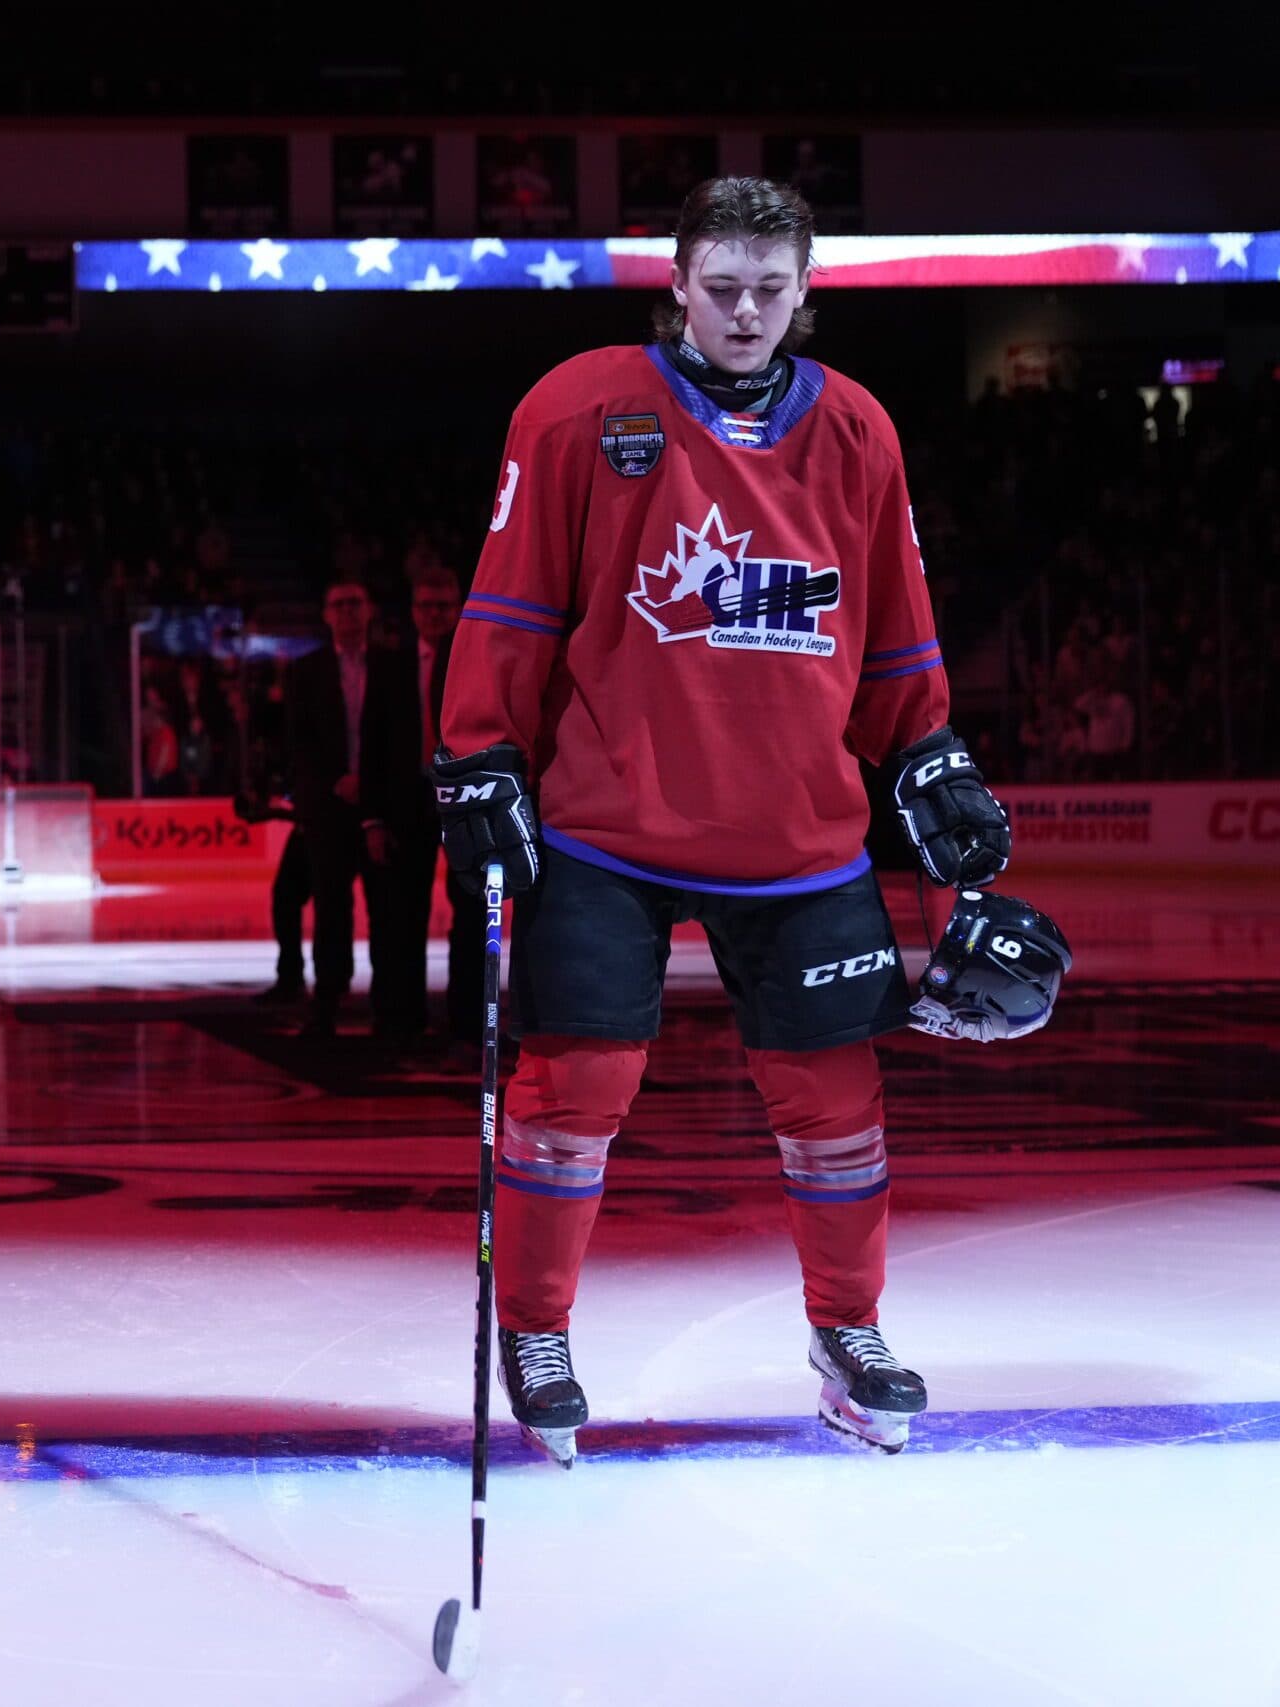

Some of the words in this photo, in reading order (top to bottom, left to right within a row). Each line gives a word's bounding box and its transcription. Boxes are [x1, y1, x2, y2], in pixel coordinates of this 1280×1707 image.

[701, 561, 816, 633] CHL
[711, 630, 761, 645] Canadian
[763, 633, 803, 651] Hockey
[805, 637, 833, 653] League
[913, 751, 976, 787] CC
[434, 781, 497, 803] CM
[117, 815, 250, 849] Kubota
[800, 945, 896, 988] CCM
[482, 1092, 495, 1146] BAUER
